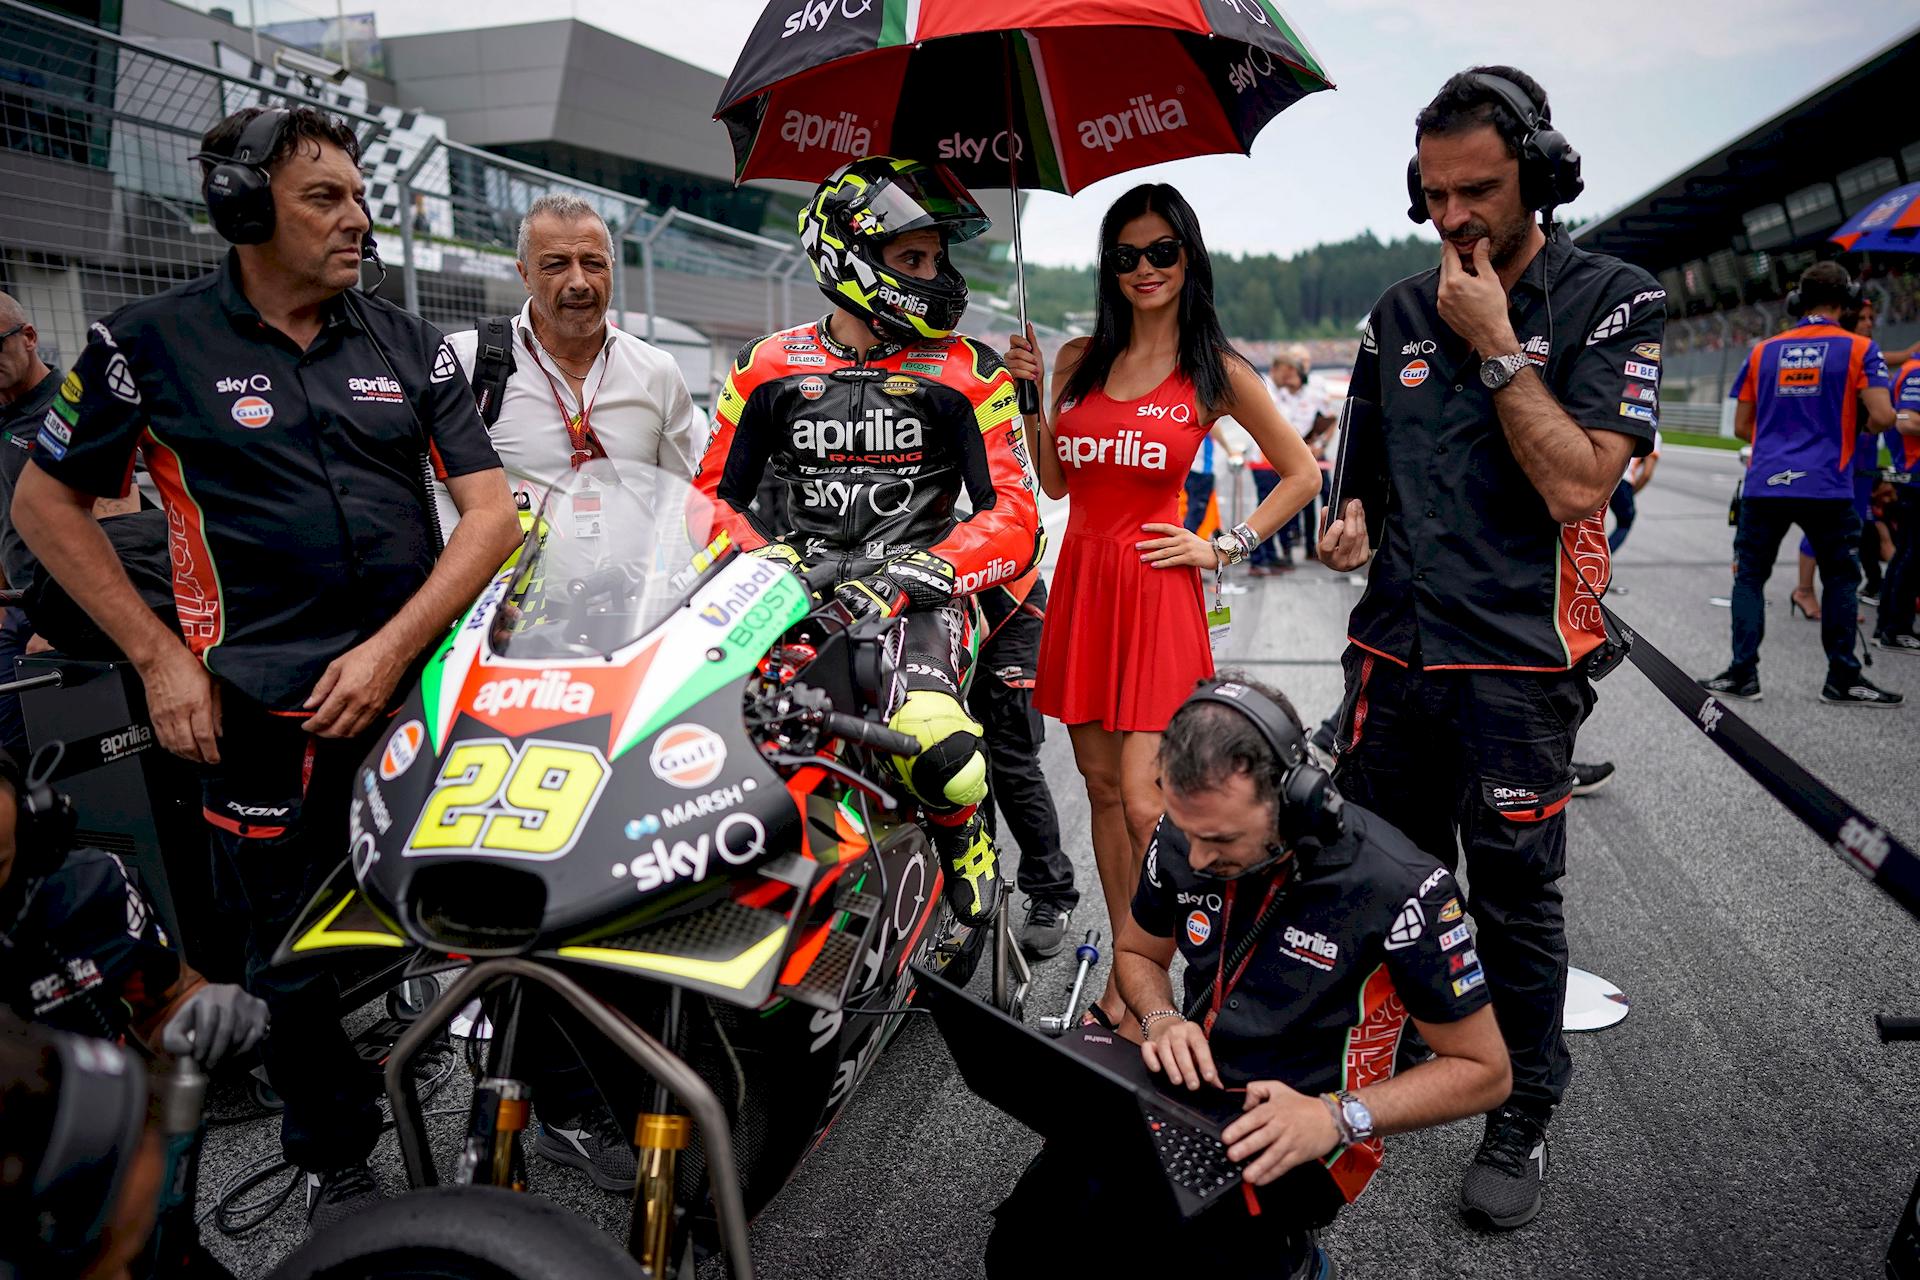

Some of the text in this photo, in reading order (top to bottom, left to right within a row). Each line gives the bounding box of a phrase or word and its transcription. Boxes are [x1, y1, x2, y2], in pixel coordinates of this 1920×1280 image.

[781, 0, 839, 39] sky
[1228, 45, 1277, 94] sky Q
[781, 109, 872, 157] aprilia
[1077, 94, 1189, 152] aprilia
[937, 130, 1024, 164] sky Q
[878, 286, 929, 316] aprilia
[820, 334, 843, 358] aprilia
[1400, 339, 1437, 356] sky Q
[834, 369, 880, 377] SPIDI
[905, 362, 938, 373] BOOST
[1402, 368, 1428, 379] Gulf
[215, 374, 273, 394] sky Q
[347, 376, 402, 394] aprilia
[800, 384, 825, 392] Gulf
[236, 407, 271, 418] Gulf
[1136, 403, 1190, 424] sky Q
[792, 408, 923, 458] aprilia
[828, 451, 923, 464] RACING
[1056, 430, 1168, 470] aprilia
[799, 465, 848, 475] TEAM
[801, 477, 915, 517] sky Q
[952, 557, 1017, 596] aprilia
[698, 562, 776, 627] Unibat
[728, 577, 793, 648] BOOST
[472, 670, 595, 716] aprilia
[100, 724, 151, 755] aprilia
[659, 742, 718, 770] Gulf
[226, 800, 290, 817] IXON
[402, 737, 613, 861] 29
[661, 784, 744, 828] MARSH
[630, 812, 766, 892] sky Q
[1177, 892, 1222, 913] sky Q
[1188, 920, 1209, 936] Gulf
[1283, 925, 1339, 960] aprilia
